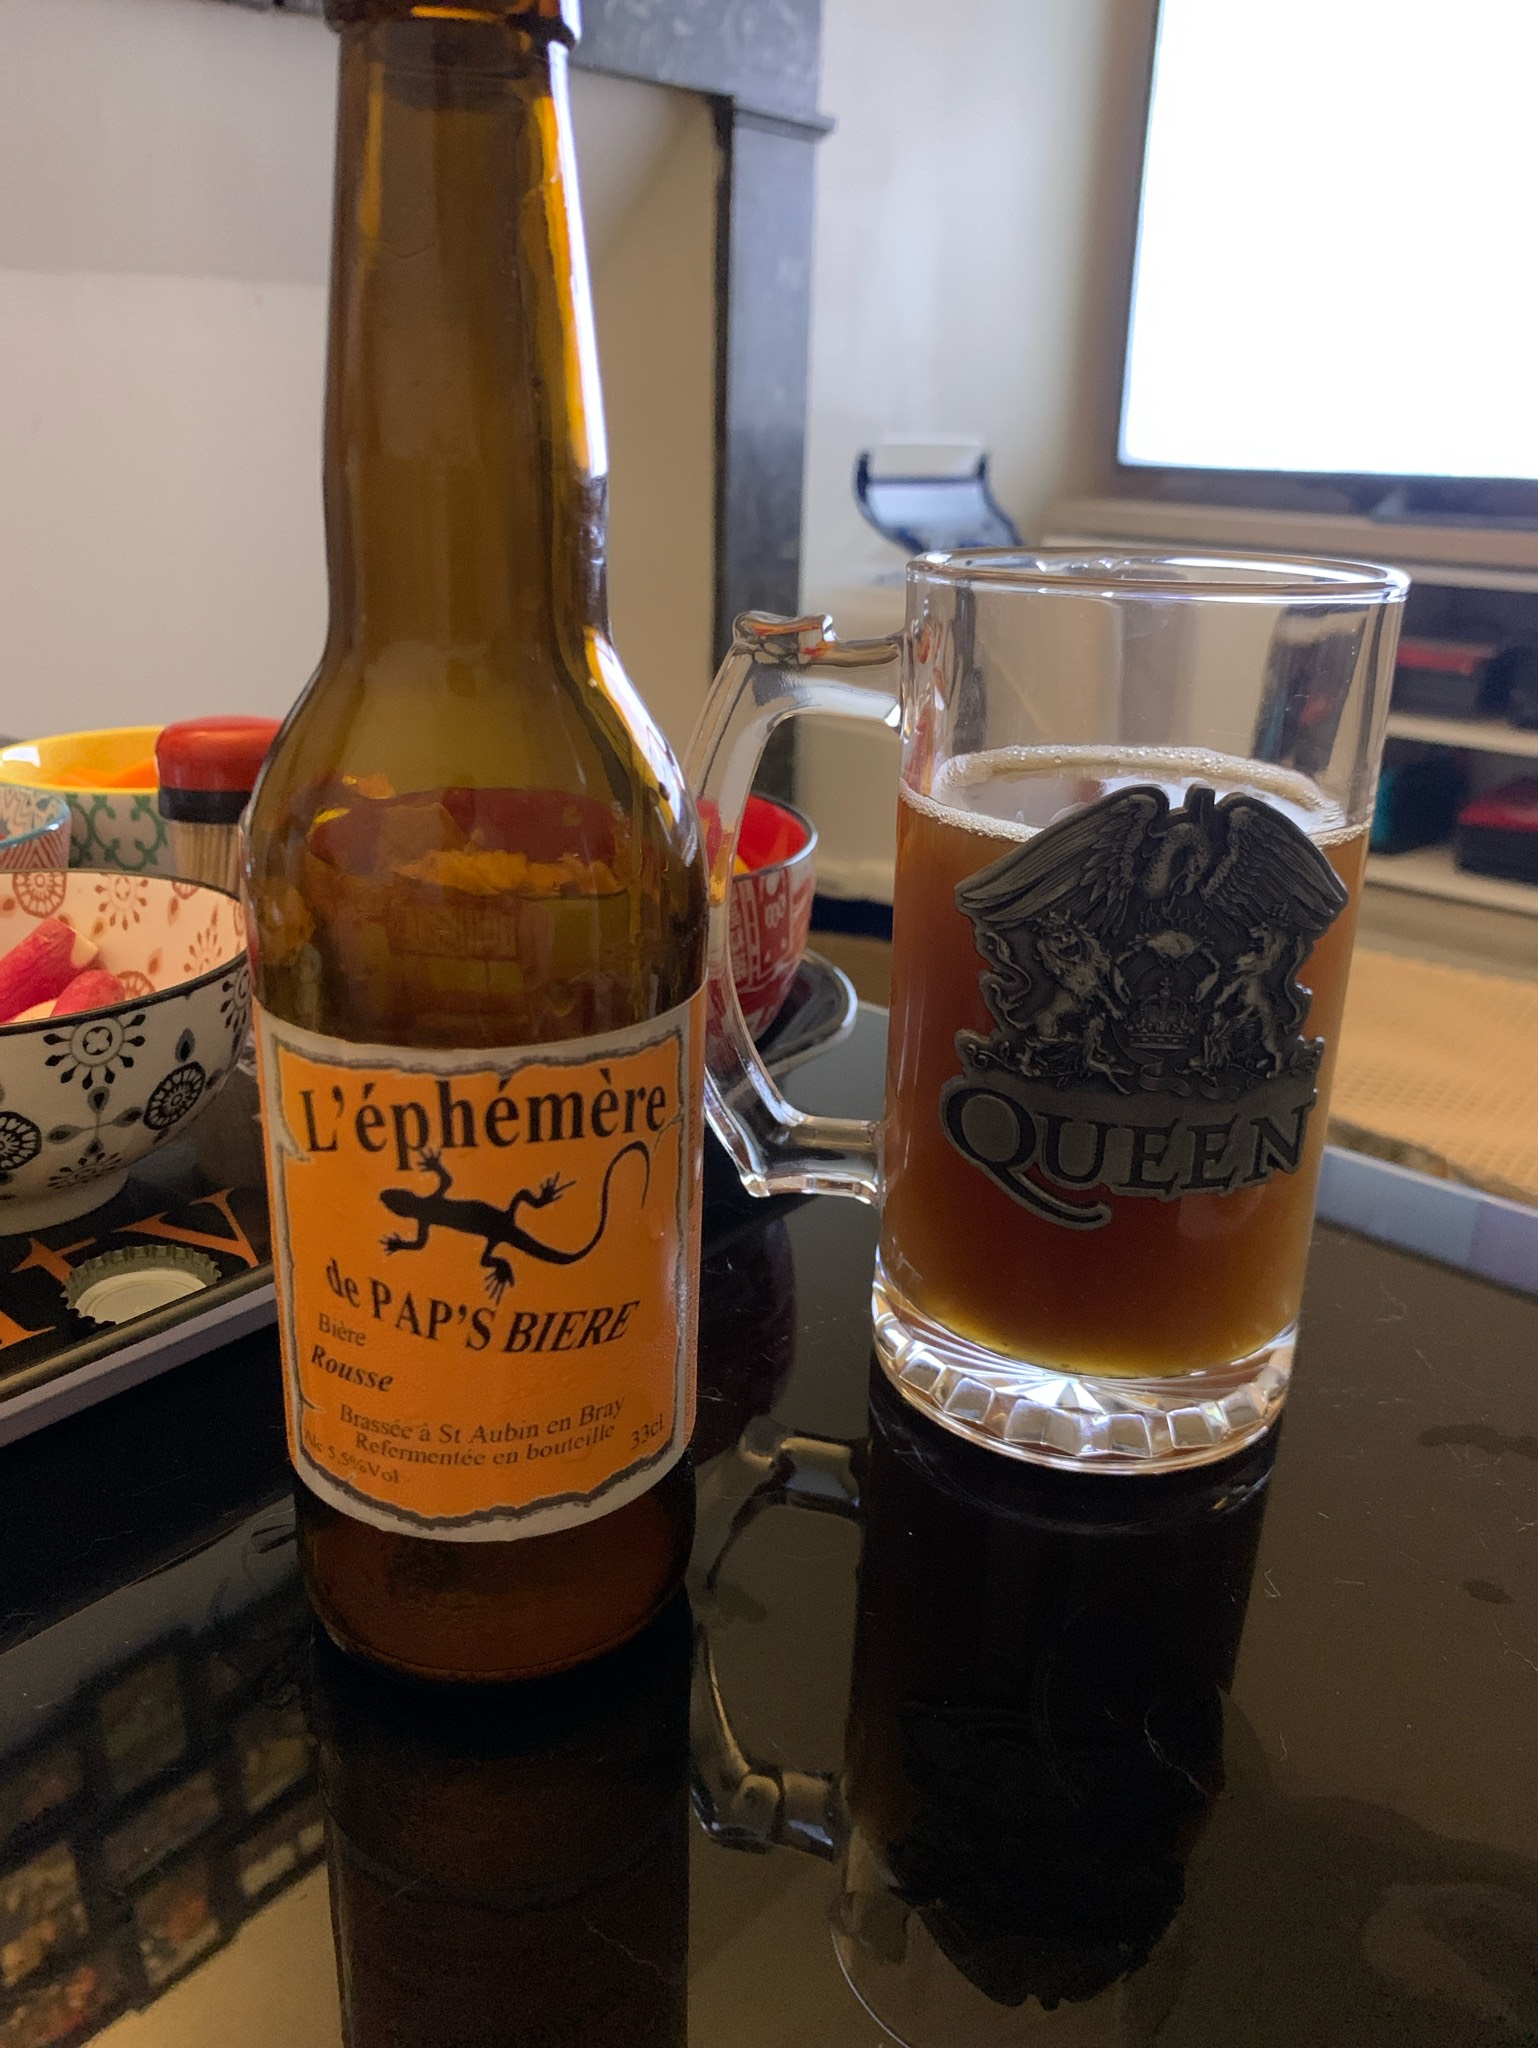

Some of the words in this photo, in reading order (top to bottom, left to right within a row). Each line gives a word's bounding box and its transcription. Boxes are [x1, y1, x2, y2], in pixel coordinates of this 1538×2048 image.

[299, 1069, 667, 1171] L'éphémère
[946, 1088, 1313, 1224] QUEEN
[318, 1312, 366, 1346] Bière
[326, 1257, 361, 1308] de
[369, 1277, 496, 1351] PAP'S
[502, 1300, 641, 1354] BIERE
[310, 1344, 394, 1392] Rousse
[339, 1402, 413, 1439] Brassée
[439, 1423, 461, 1443] St
[468, 1420, 539, 1444] Aubin
[547, 1416, 571, 1434] en
[579, 1397, 625, 1427] Bray
[631, 1412, 664, 1450] 33cl
[355, 1431, 485, 1466] Refermentée
[493, 1451, 518, 1465] en
[526, 1423, 615, 1461] bouteille
